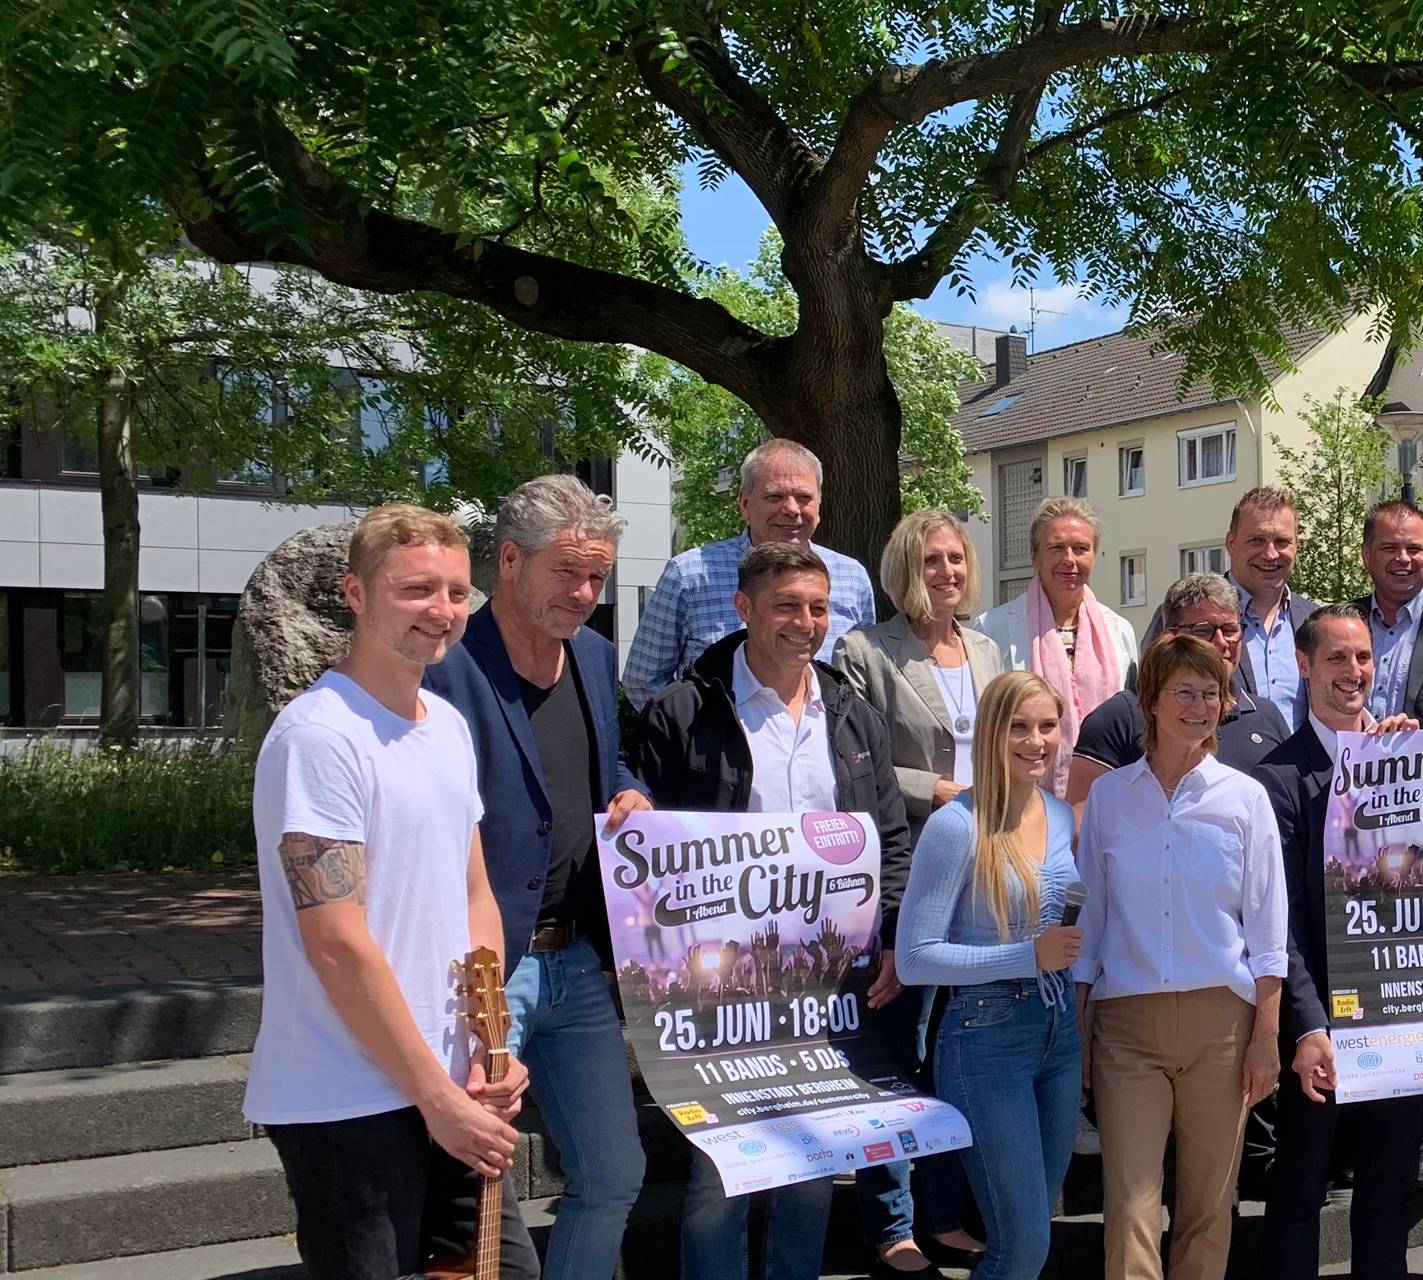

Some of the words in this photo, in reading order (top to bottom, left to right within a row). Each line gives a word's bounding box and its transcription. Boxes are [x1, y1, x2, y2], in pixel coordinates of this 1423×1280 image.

[1371, 792, 1388, 809] in
[1393, 787, 1420, 805] the
[814, 818, 847, 833] FREIER
[1379, 816, 1383, 825] 1
[1385, 811, 1413, 825] Abend
[814, 831, 860, 849] EINTRITT!
[613, 826, 795, 889] Summer
[675, 880, 696, 902] in
[702, 873, 733, 895] the
[738, 864, 825, 924] City
[829, 880, 836, 891] 6
[836, 876, 866, 890] Bühnen
[685, 909, 691, 921] 1
[693, 902, 727, 920] Abend
[1346, 900, 1386, 935] 25.
[1371, 947, 1390, 970] 11
[654, 1008, 706, 1051] 25.
[712, 1001, 771, 1047] JUNI
[789, 993, 860, 1037] 18:00
[1336, 1030, 1423, 1050] westenergie
[694, 1062, 723, 1085] 11
[720, 1054, 788, 1082] BANDS
[800, 1050, 818, 1072] 5
[814, 1047, 850, 1071] DJs
[721, 1085, 800, 1105] INNENSTADT
[796, 1078, 860, 1096] BERGHEIM
